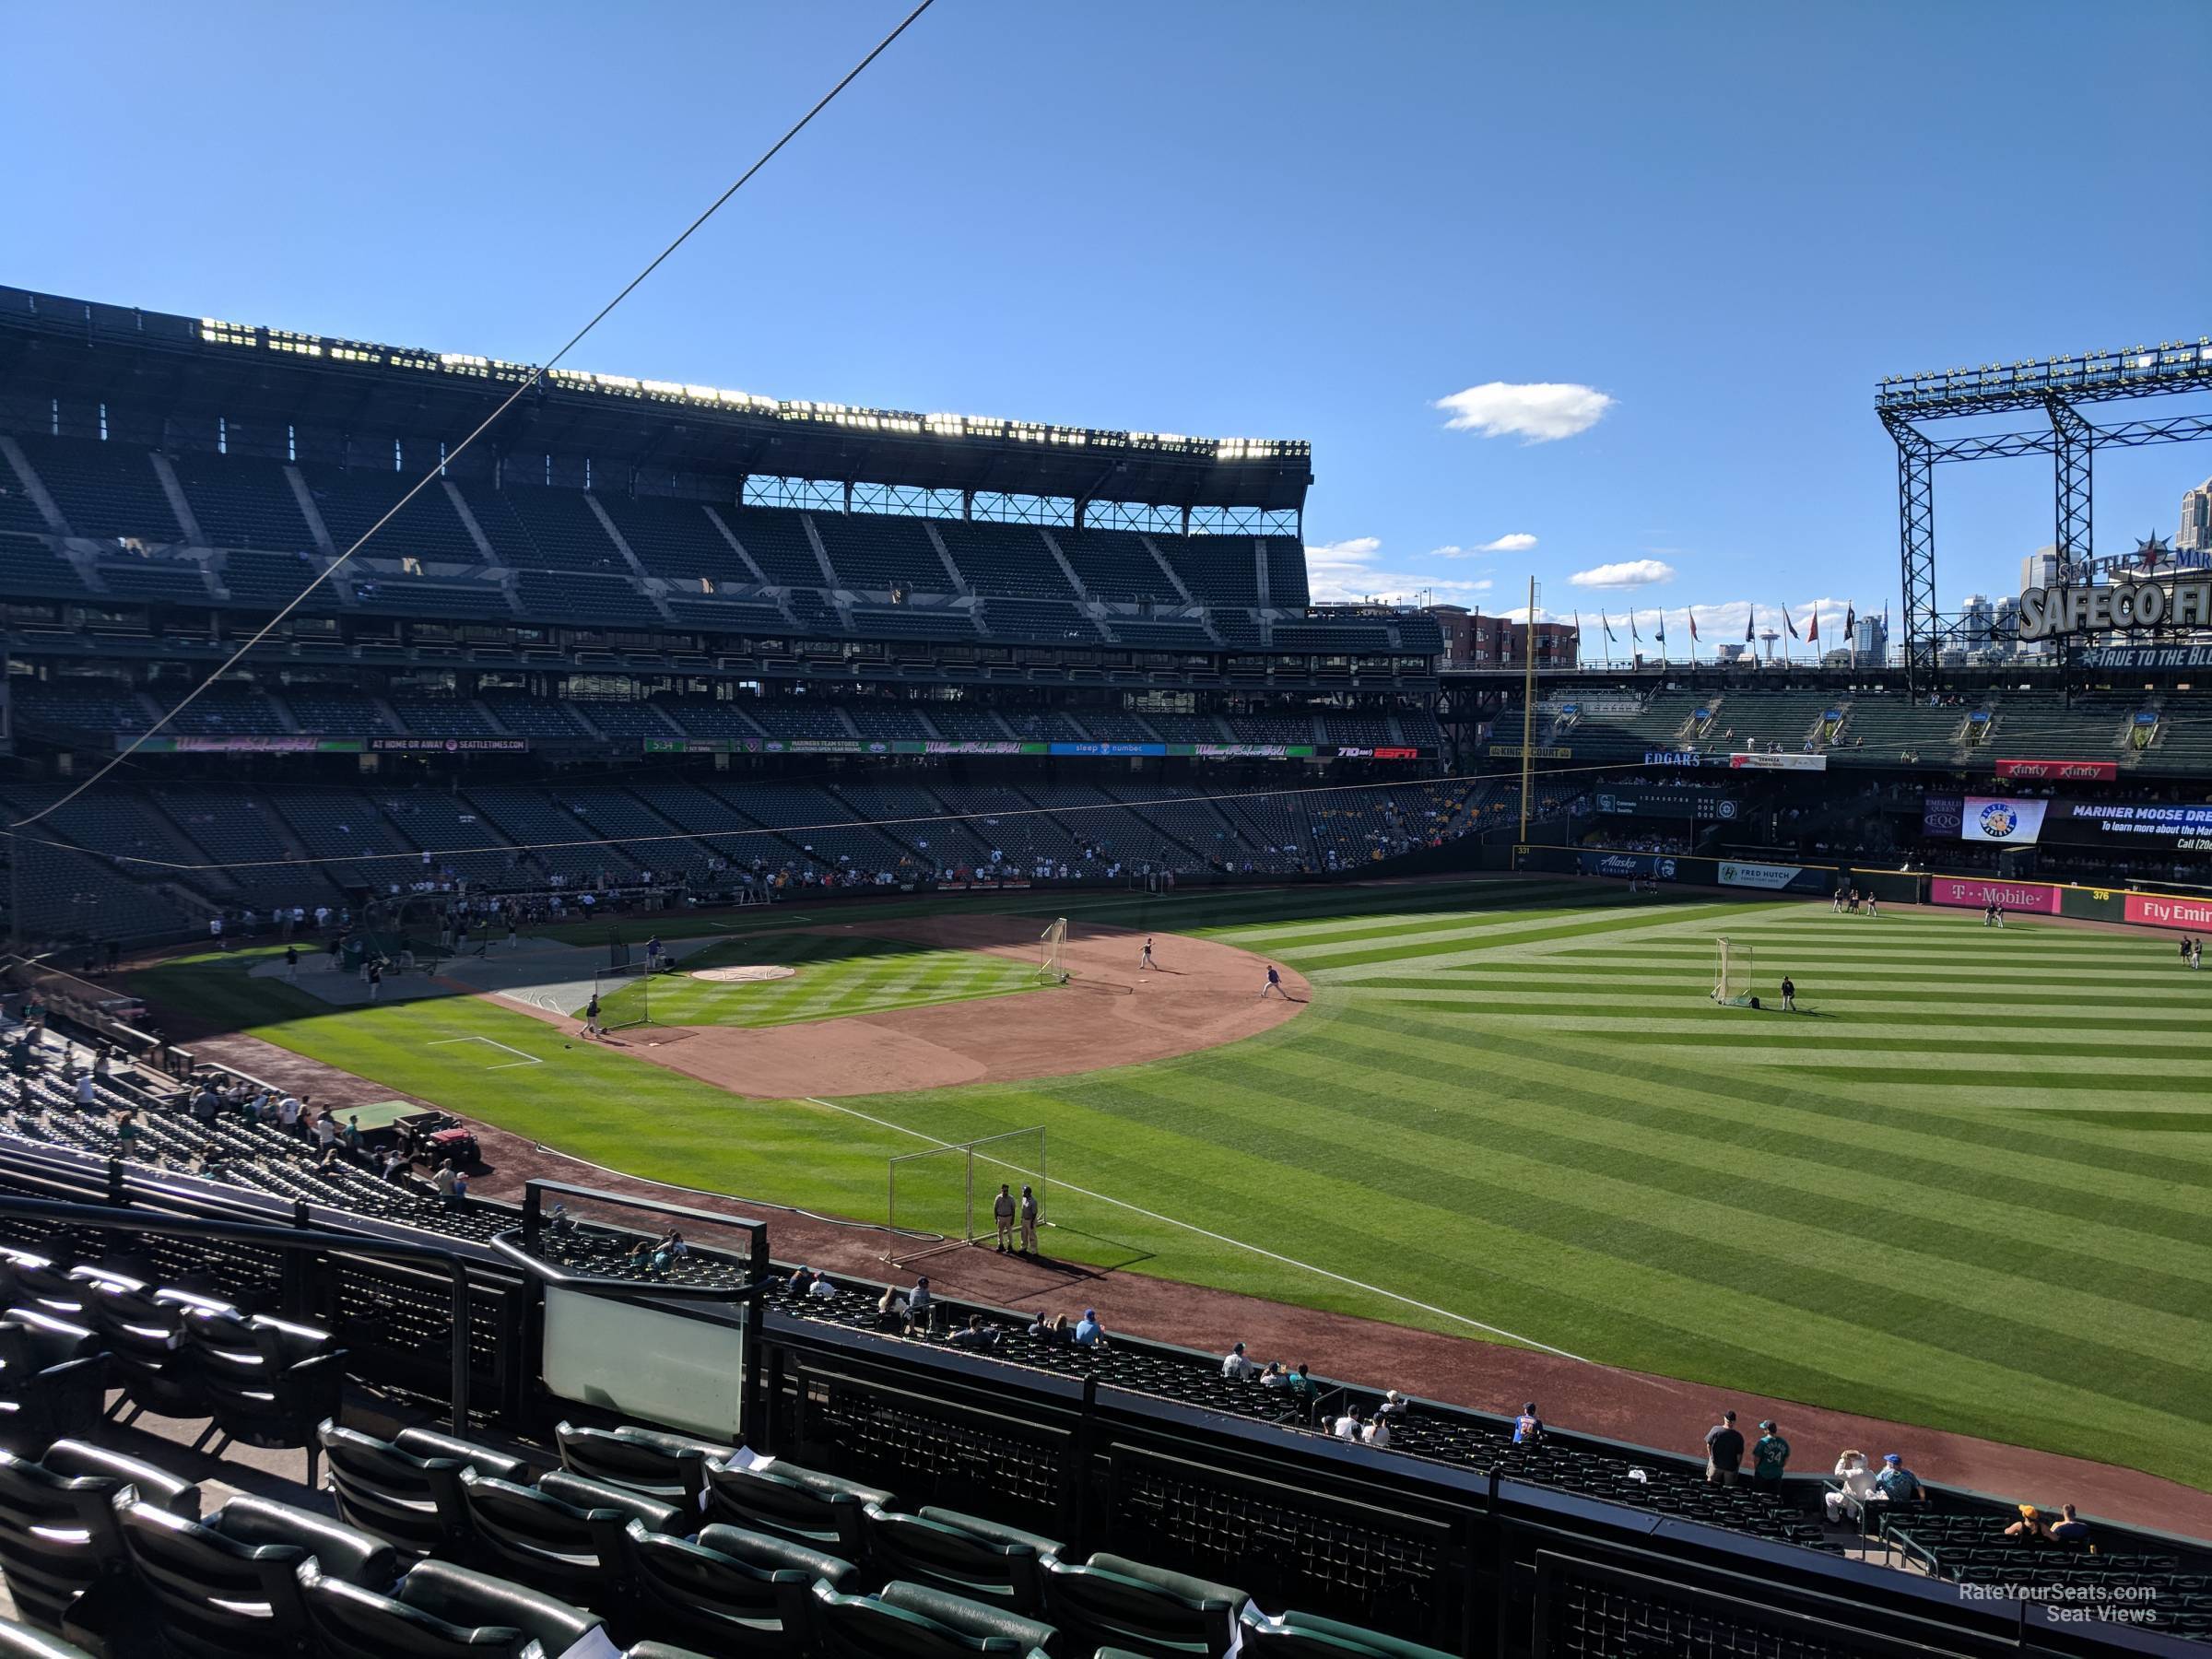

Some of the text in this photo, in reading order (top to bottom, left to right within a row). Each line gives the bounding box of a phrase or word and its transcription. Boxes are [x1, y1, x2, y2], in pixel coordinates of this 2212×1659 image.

[2058, 554, 2134, 583] SEATTLE
[2020, 582, 2212, 641] SAFECO FI
[2099, 648, 2136, 666] TRUE
[2139, 650, 2157, 665] TO
[2159, 649, 2187, 665] THE
[1374, 747, 1417, 759] ESPN
[2074, 805, 2134, 818] MARINER
[2136, 808, 2184, 821] MOOSE
[2102, 821, 2112, 830] To
[2112, 821, 2133, 831] learn
[2134, 824, 2155, 833] more
[2156, 824, 2179, 834] about
[2181, 825, 2194, 835] the
[2177, 839, 2194, 848] Call
[1601, 855, 1637, 869] Alaska
[1763, 871, 1789, 879] HUTCH
[2093, 890, 2109, 900] 376
[2144, 902, 2170, 921] Fly
[1767, 1452, 1782, 1464] 34
